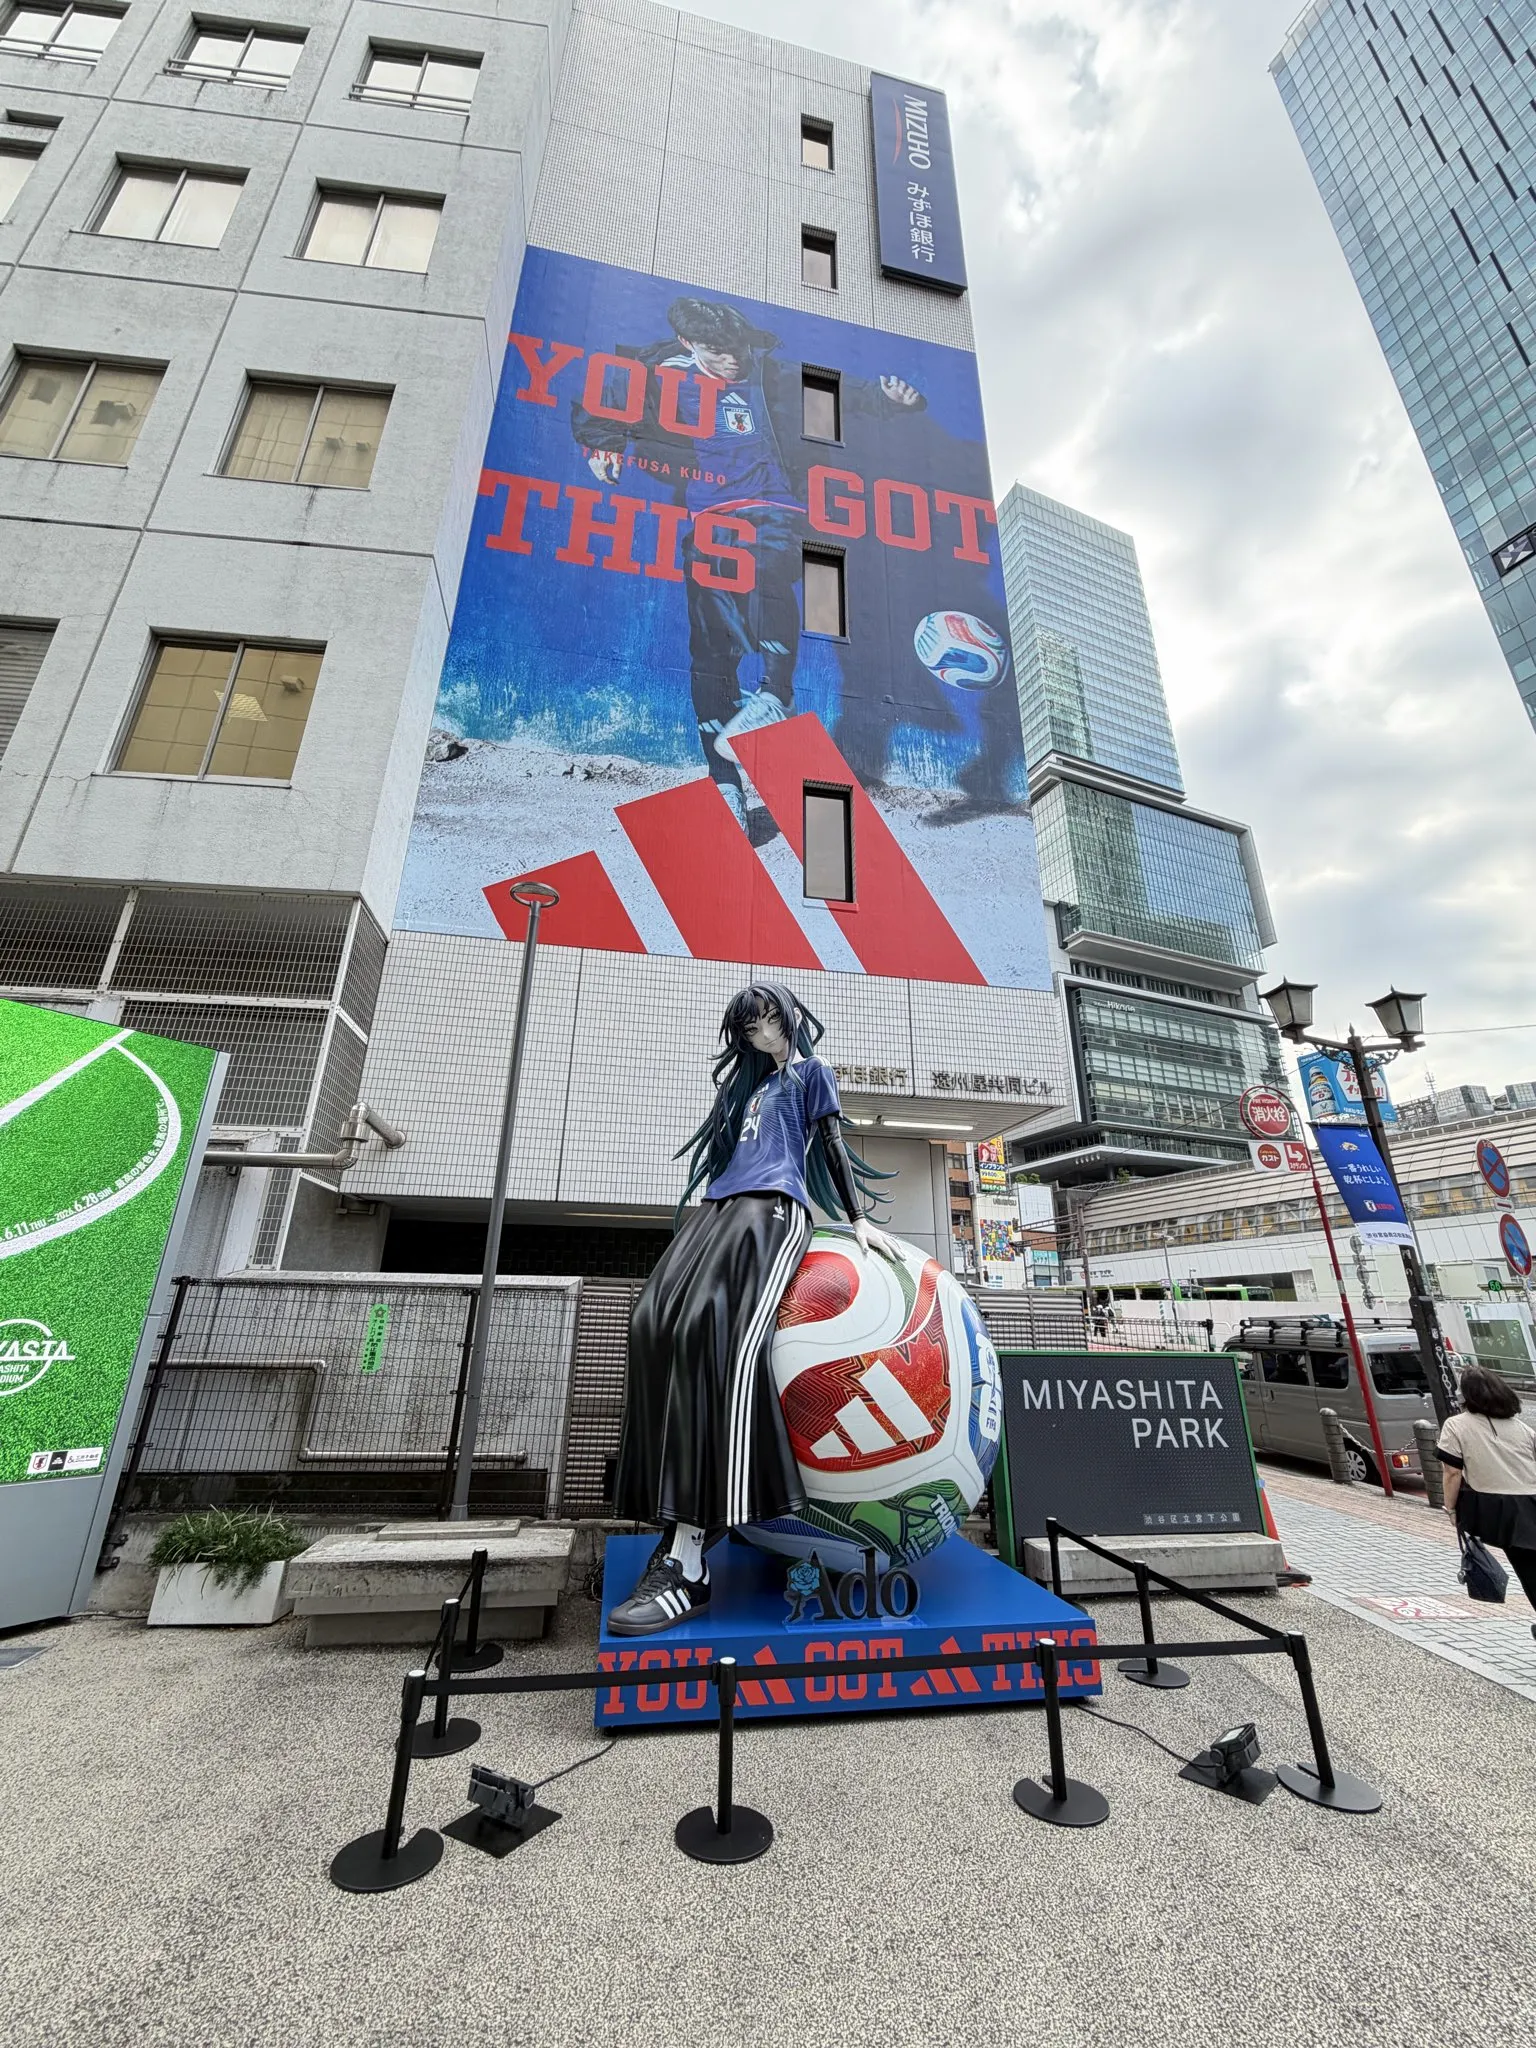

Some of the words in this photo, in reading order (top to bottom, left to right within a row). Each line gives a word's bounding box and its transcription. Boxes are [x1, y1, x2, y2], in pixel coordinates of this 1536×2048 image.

[904, 94, 930, 170] MIZUHO
[907, 182, 935, 263] みずほ銀行
[508, 333, 725, 439] YOU
[581, 446, 670, 475] TAKEFUSA
[680, 466, 726, 485] KUBO
[479, 469, 756, 594] THIS
[808, 465, 998, 565] GOT
[832, 1065, 907, 1087] ずほ銀行
[740, 1117, 761, 1142] 24
[1252, 1106, 1287, 1122] 消火栓
[1338, 1164, 1382, 1173] 一番うれしい
[1343, 1175, 1390, 1186] 乾杯にしよう。
[1022, 1379, 1223, 1410] MIYASHITA
[1132, 1418, 1229, 1448] PARK
[930, 1494, 958, 1539] TRION
[1143, 1512, 1241, 1525] 渋谷区立宮下公園
[784, 1546, 919, 1622] Ado
[599, 1647, 713, 1714] YOU
